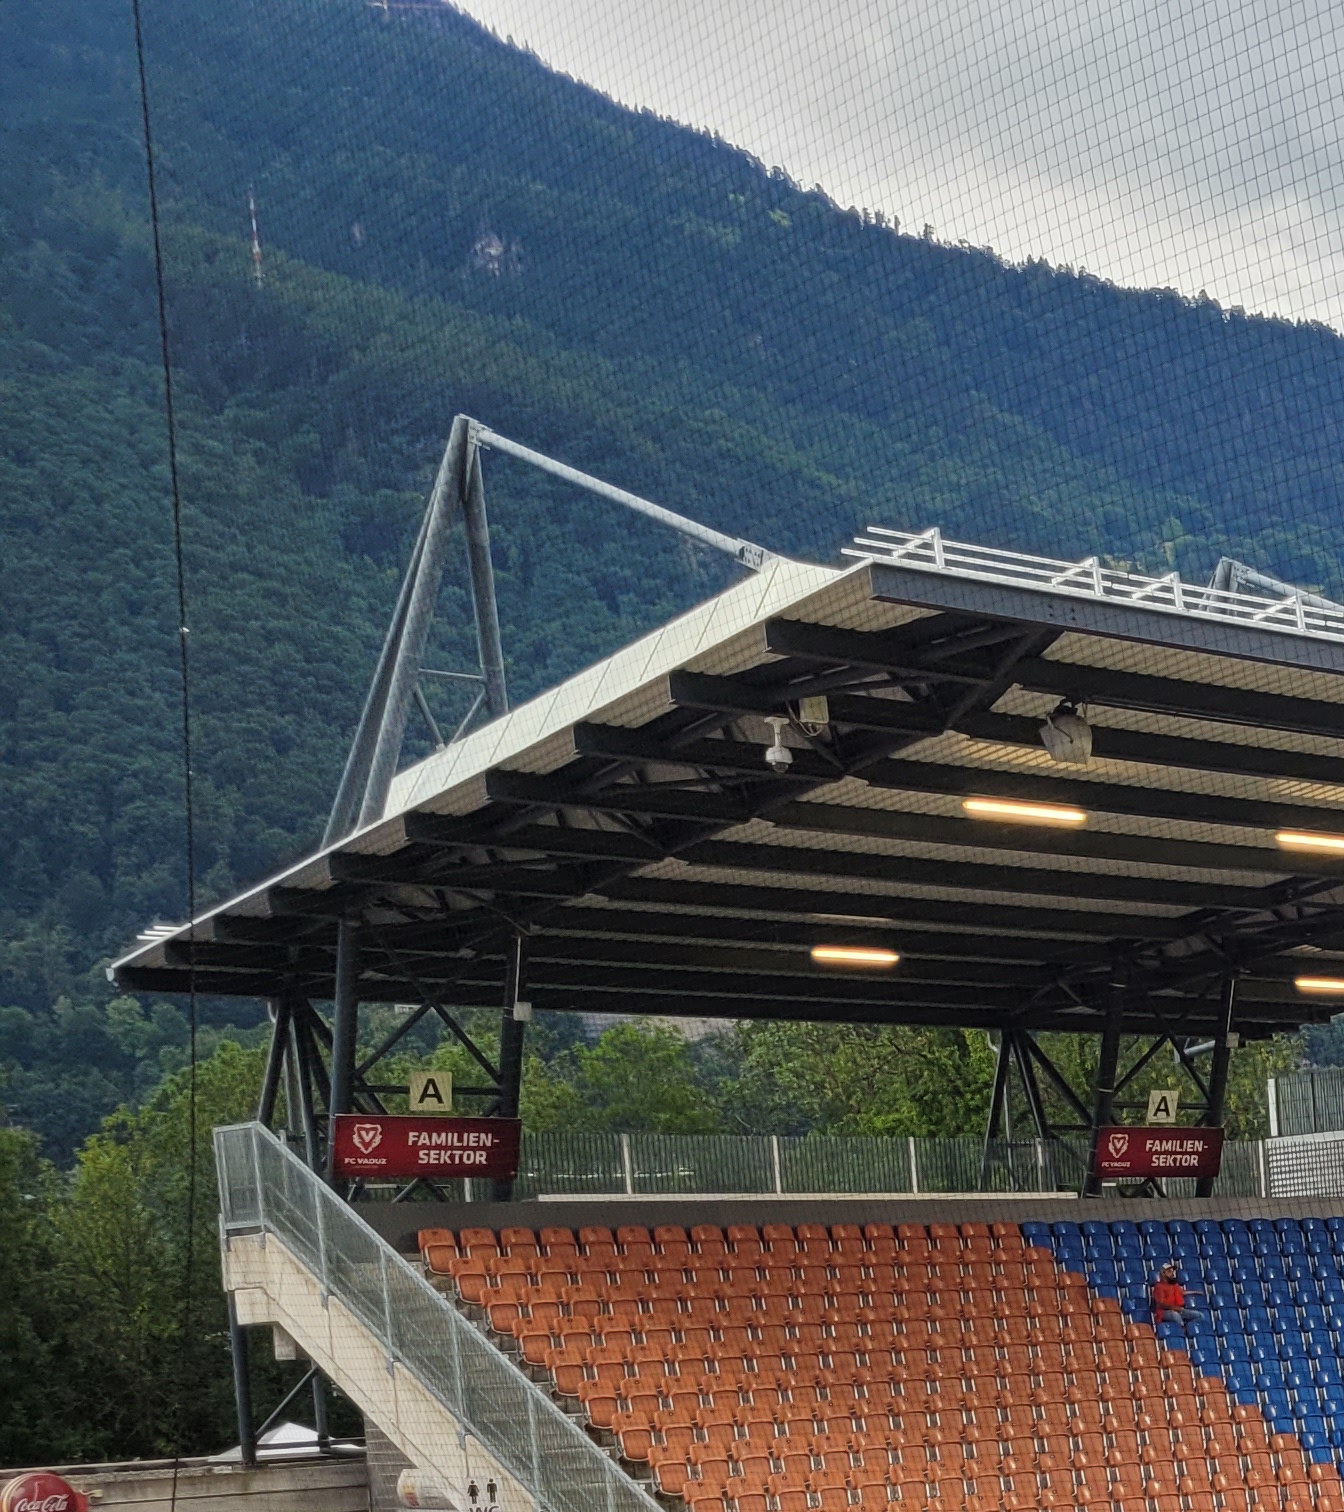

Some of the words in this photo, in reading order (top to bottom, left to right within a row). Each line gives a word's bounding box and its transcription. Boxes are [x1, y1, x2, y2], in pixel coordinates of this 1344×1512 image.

[418, 1078, 445, 1104] A
[1152, 1095, 1171, 1117] A
[408, 1131, 500, 1147] FAMILIEN-
[1145, 1139, 1209, 1153] FAMILIEN-
[344, 1157, 356, 1165] FC
[357, 1157, 387, 1165] VADUZ
[418, 1150, 488, 1165] SEKTOR
[1151, 1154, 1199, 1167] SEKTOR
